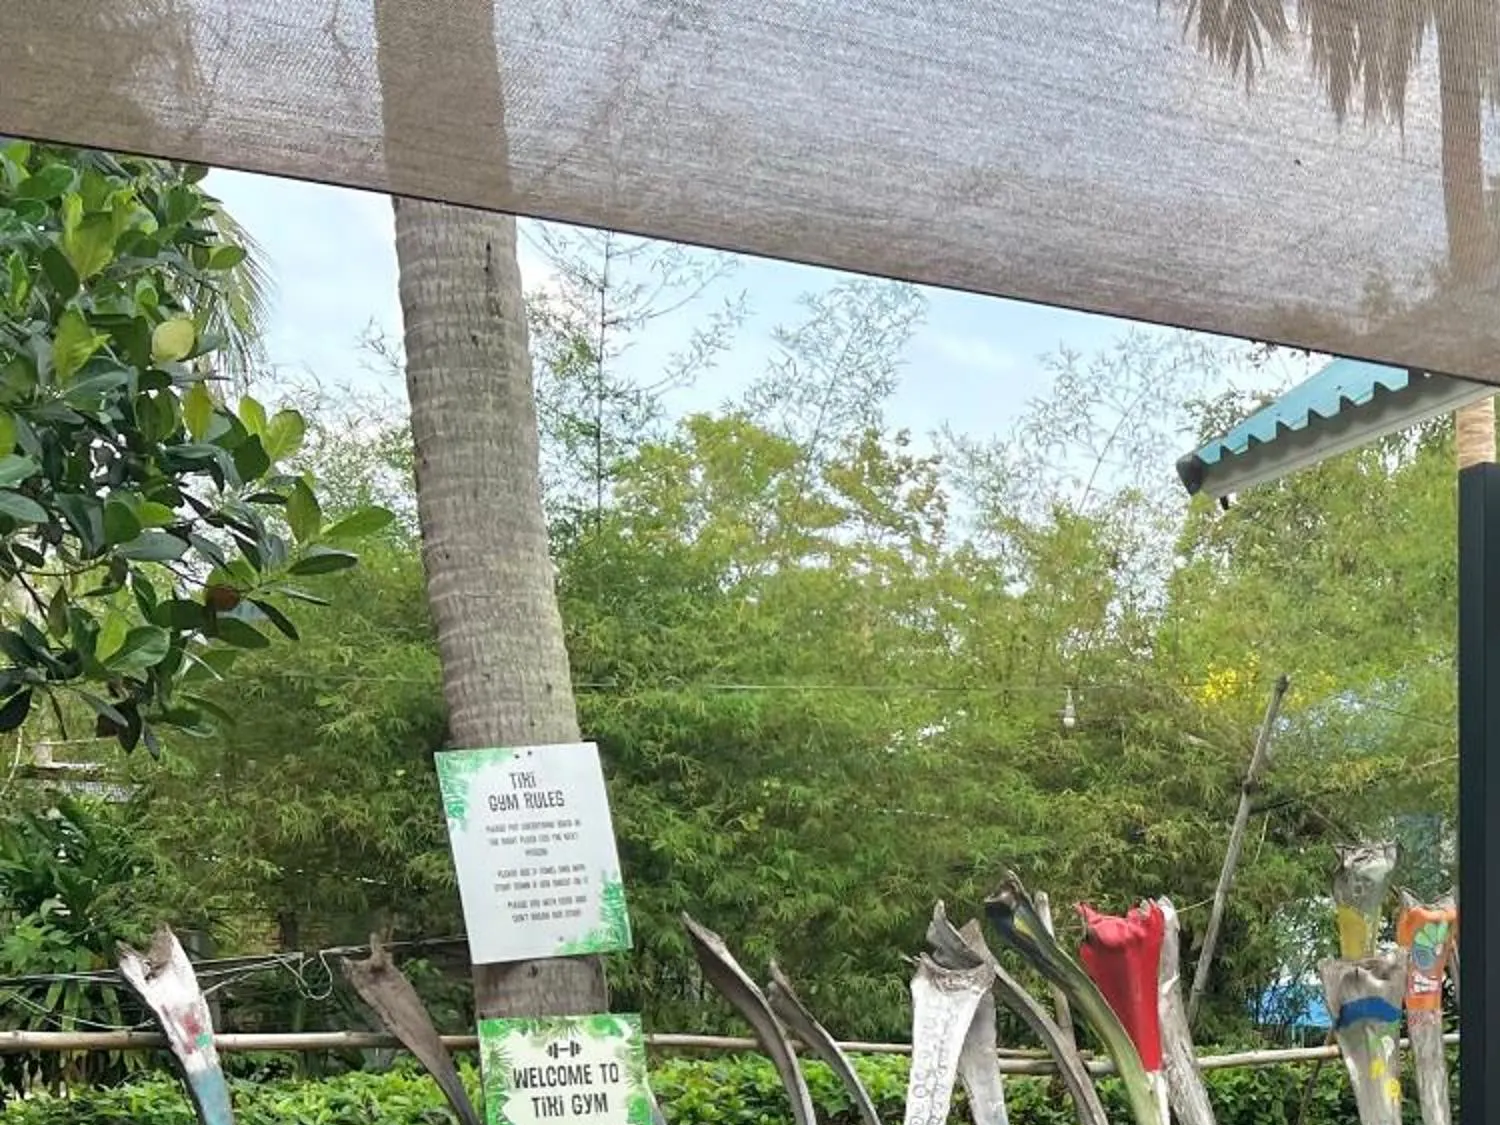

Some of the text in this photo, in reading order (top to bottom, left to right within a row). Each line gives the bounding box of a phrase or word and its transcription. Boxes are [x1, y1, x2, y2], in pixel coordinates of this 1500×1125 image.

[488, 789, 565, 812] GYM RULES
[513, 1062, 619, 1089] WELCOME TO
[571, 1092, 609, 1115] GYM
